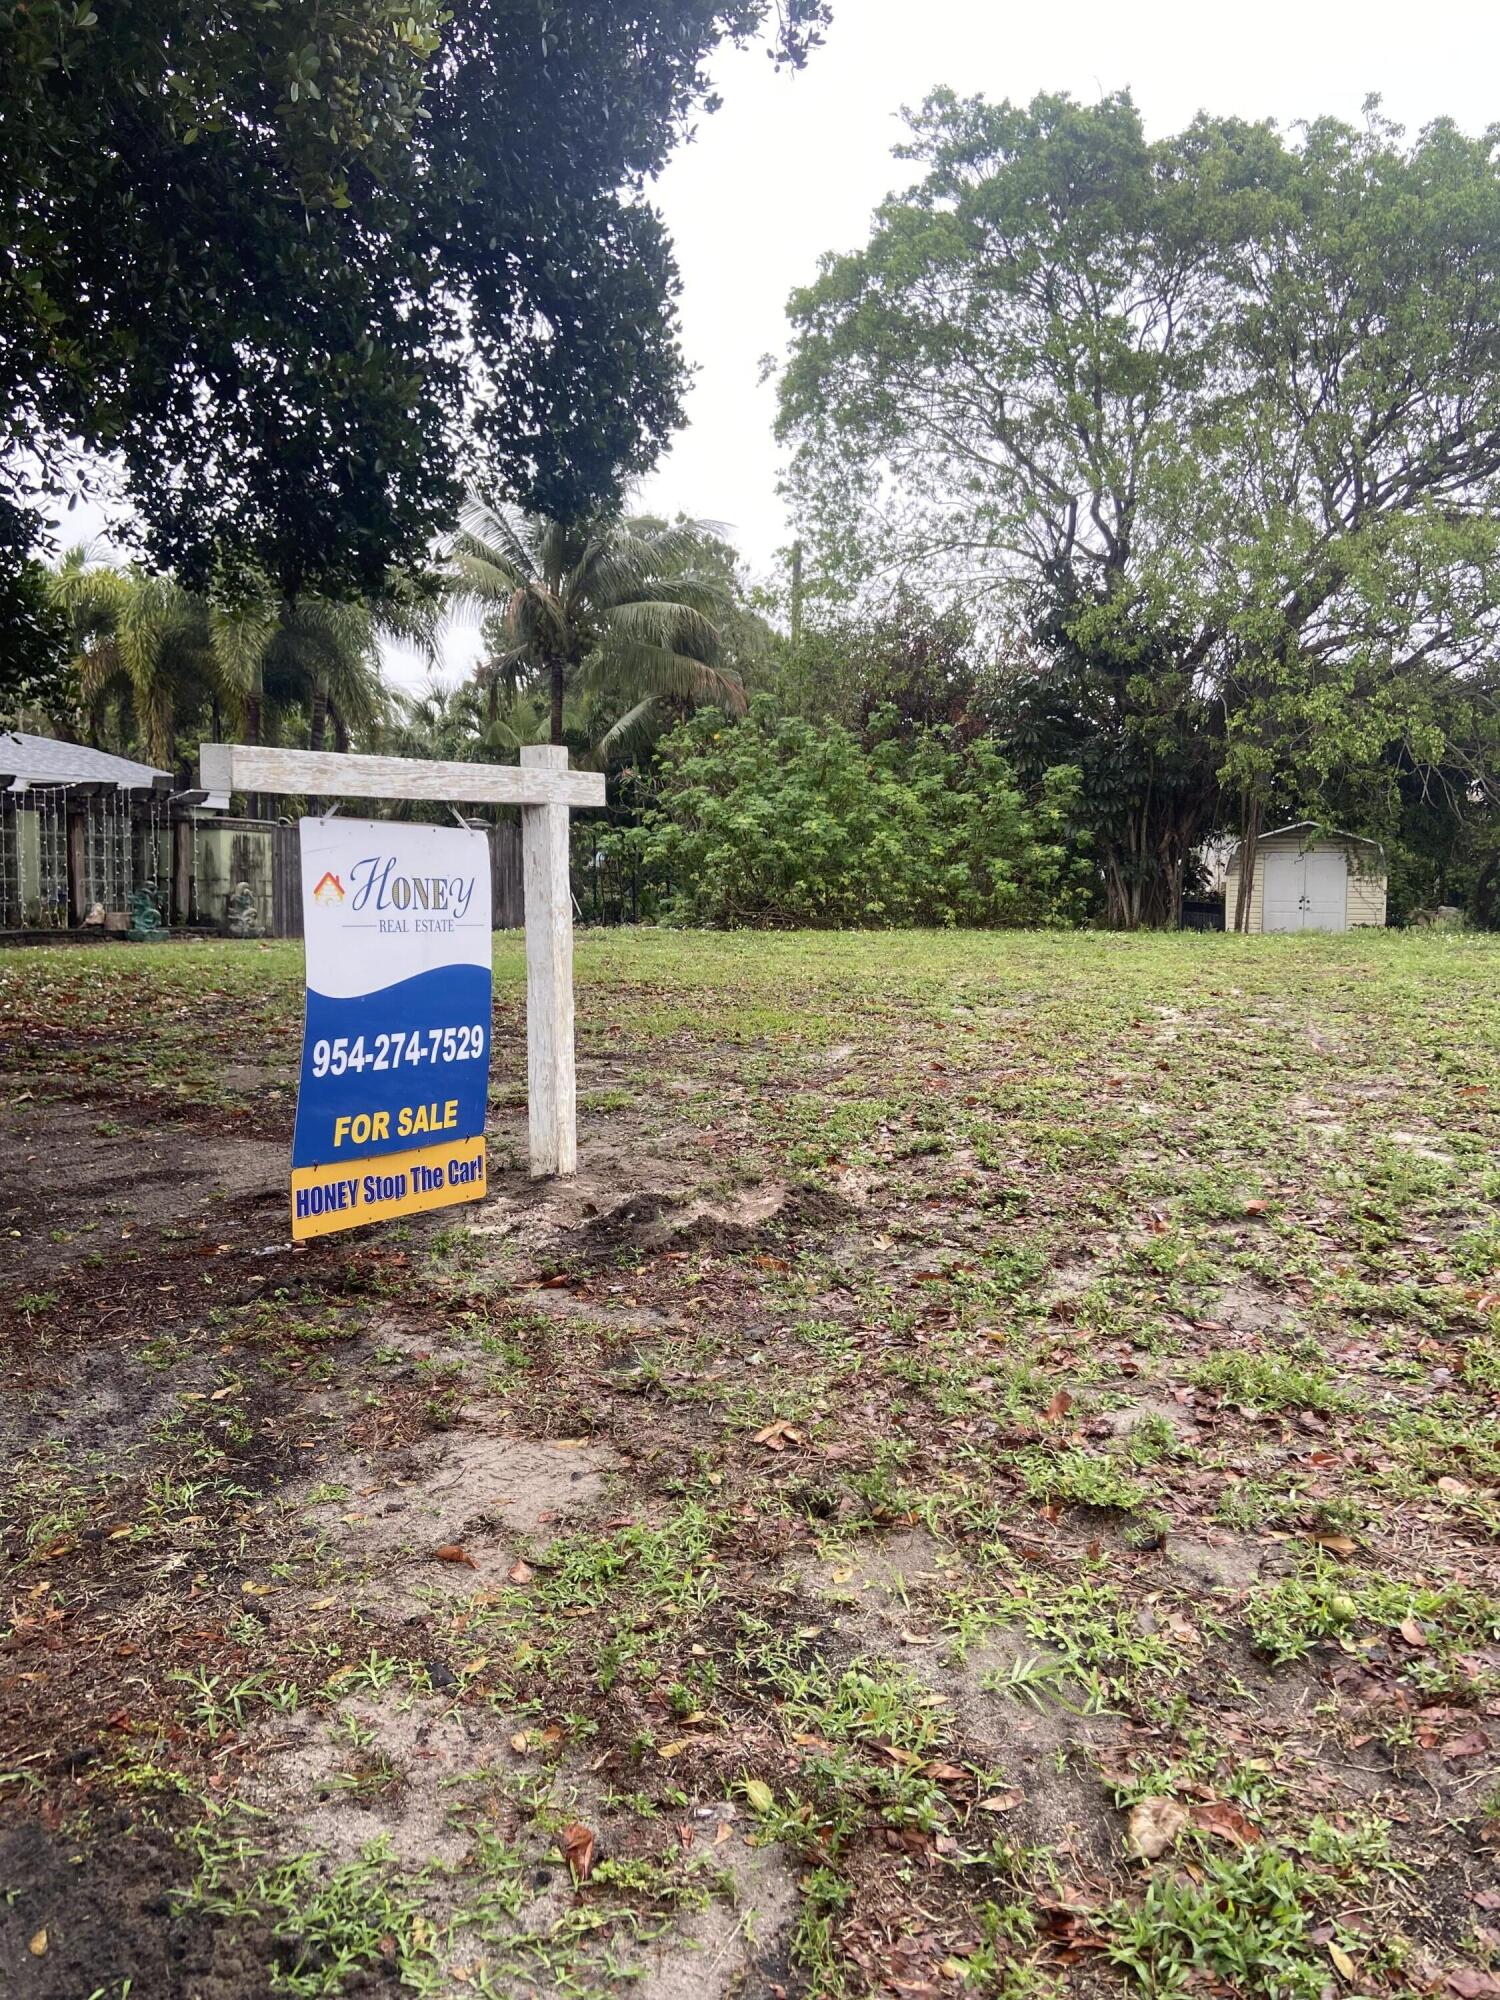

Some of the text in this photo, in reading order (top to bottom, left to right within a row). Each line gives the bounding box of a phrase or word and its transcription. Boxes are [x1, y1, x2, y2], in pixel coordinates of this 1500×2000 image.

[379, 919, 455, 933] REAL ESTATE
[312, 1024, 484, 1077] 954-274-7529
[333, 1099, 459, 1147] FOR SALE
[296, 1155, 483, 1218] HONEY Stop The Car!
